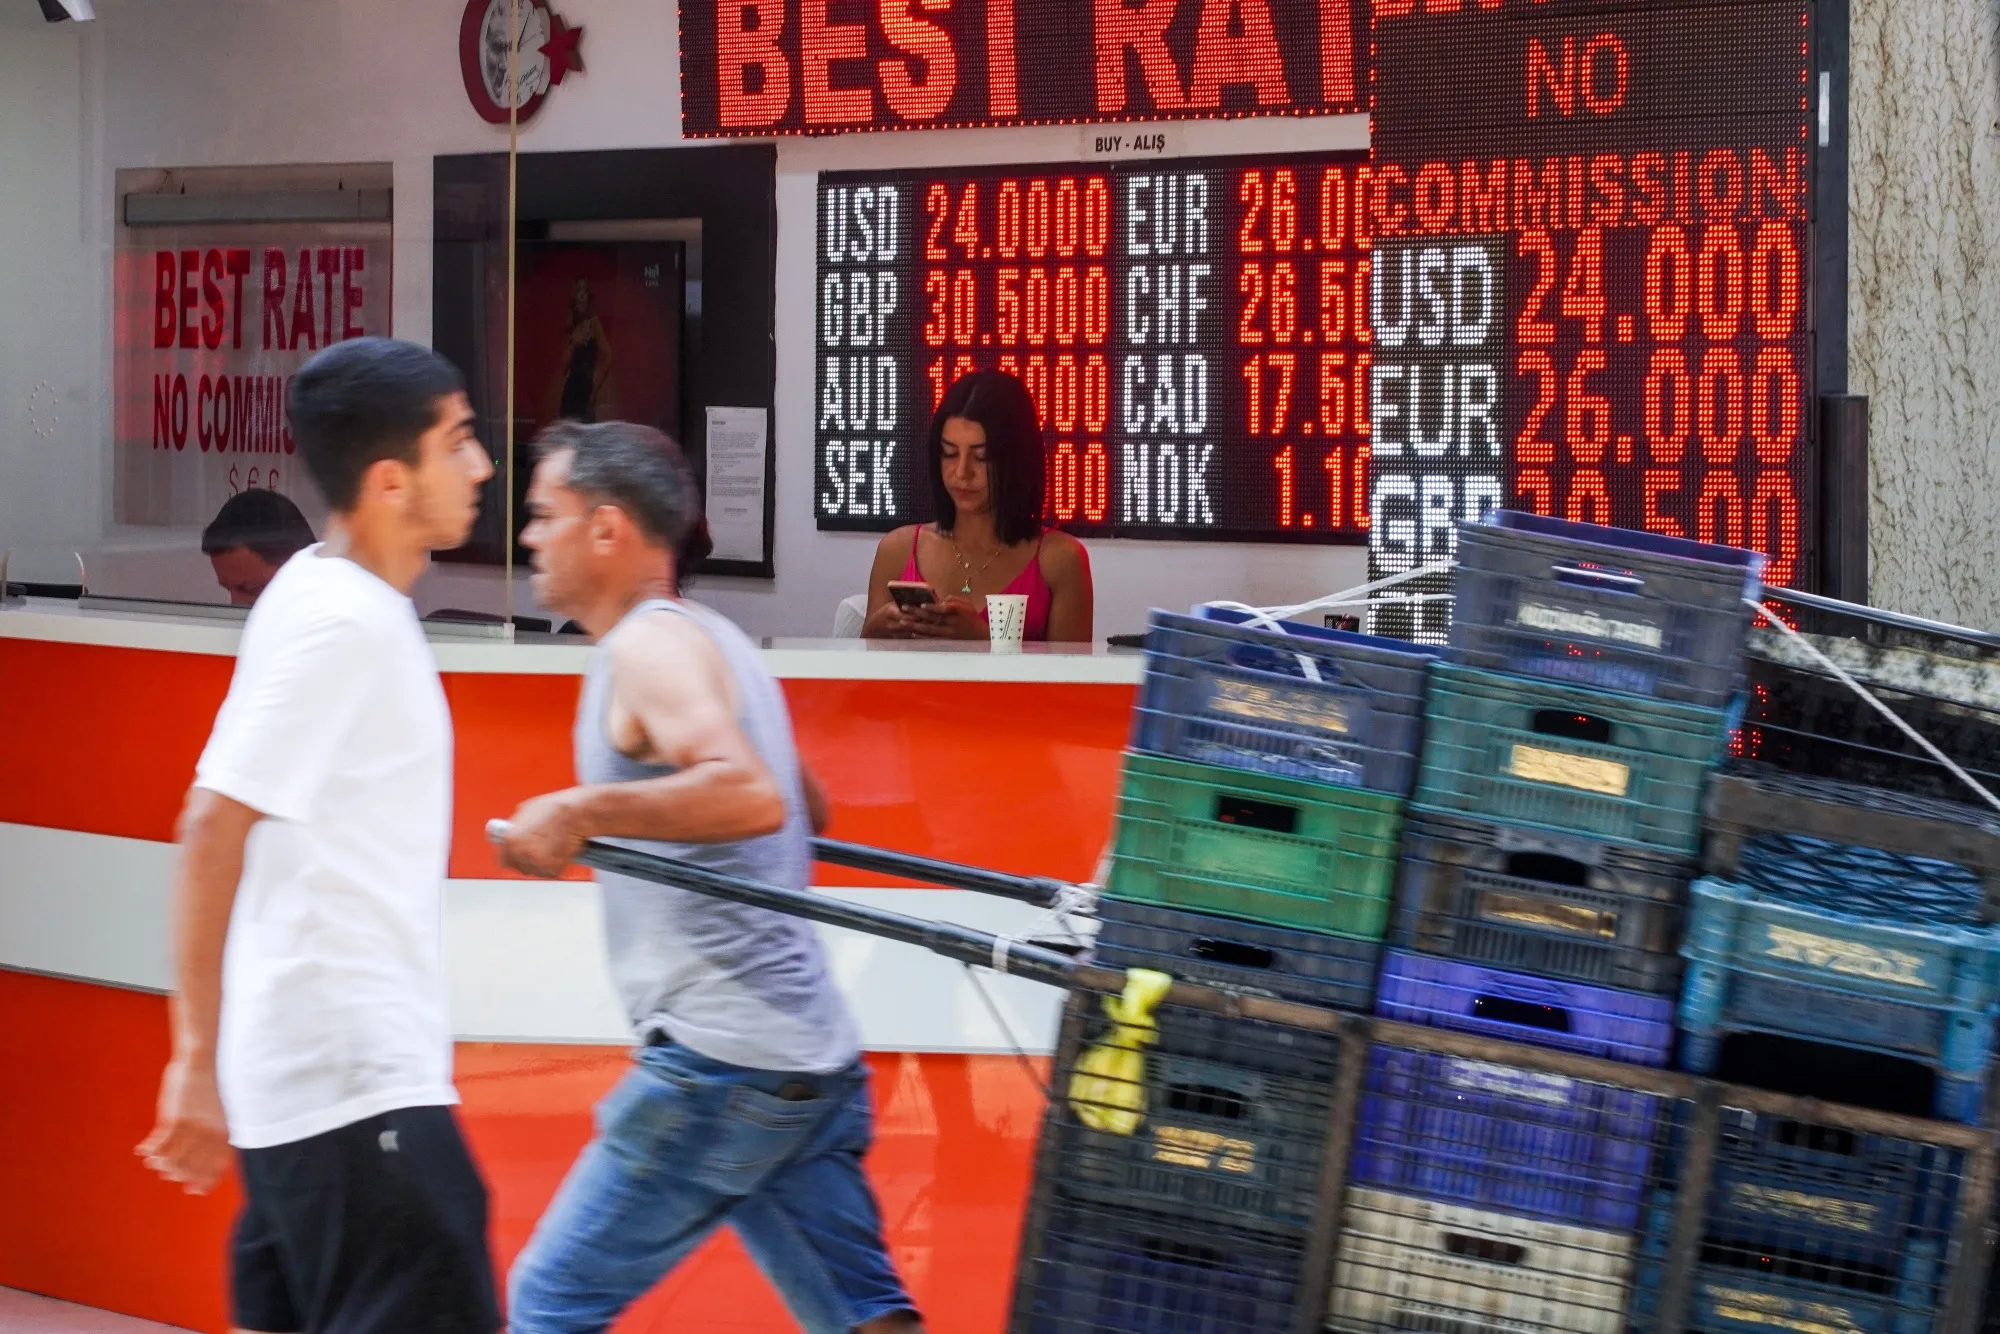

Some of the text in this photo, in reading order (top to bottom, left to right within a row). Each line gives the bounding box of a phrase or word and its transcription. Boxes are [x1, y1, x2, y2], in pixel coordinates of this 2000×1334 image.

[1526, 32, 1629, 118] NO
[1095, 136, 1122, 152] BUY
[1133, 134, 1165, 153] ALIŞ
[826, 186, 898, 262] USD
[926, 178, 1108, 260] 24.0000
[1128, 174, 1208, 255] EUR
[1371, 147, 1798, 235] COMMISSION
[154, 247, 364, 350] BEST RATE
[824, 270, 898, 346] GBP
[925, 266, 1107, 346] 30.5000
[1128, 264, 1211, 344] CHF
[1371, 223, 1798, 346] USD 24.000
[153, 373, 189, 451] NO
[820, 356, 897, 431] AUD
[1124, 354, 1207, 434] CAD
[1371, 346, 1798, 463] EUR 26.000
[822, 440, 896, 516] SEK
[1123, 444, 1213, 524] NOK
